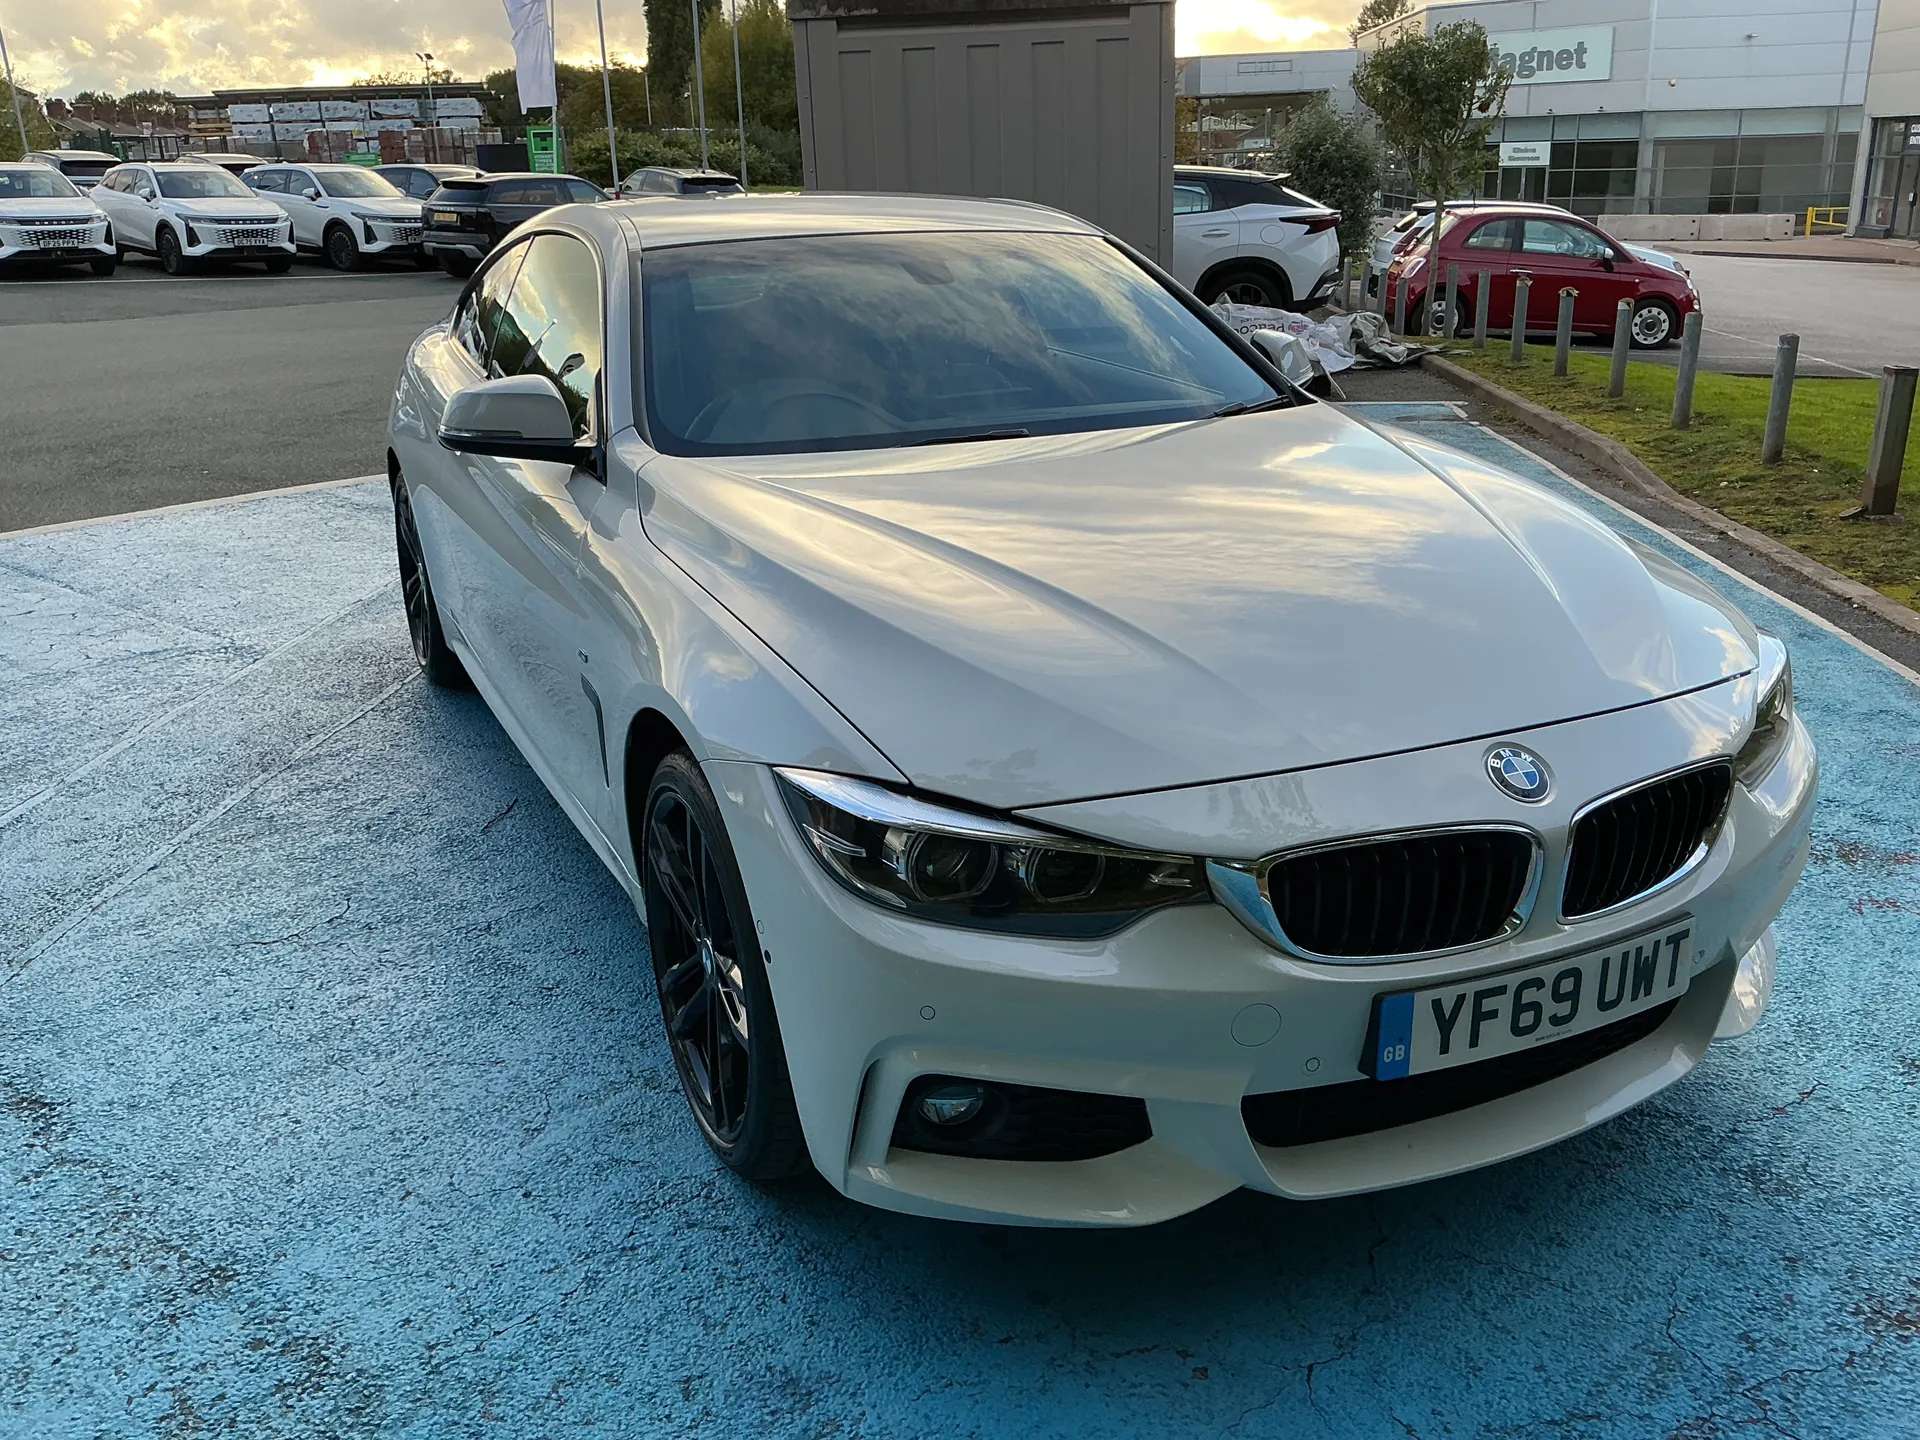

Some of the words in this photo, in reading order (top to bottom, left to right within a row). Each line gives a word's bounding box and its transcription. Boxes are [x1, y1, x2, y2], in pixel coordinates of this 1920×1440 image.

[1490, 749, 1533, 767] BMW
[1430, 966, 1583, 1056] YF69
[1596, 928, 1691, 1012] UWT
[1383, 1044, 1405, 1063] GB
